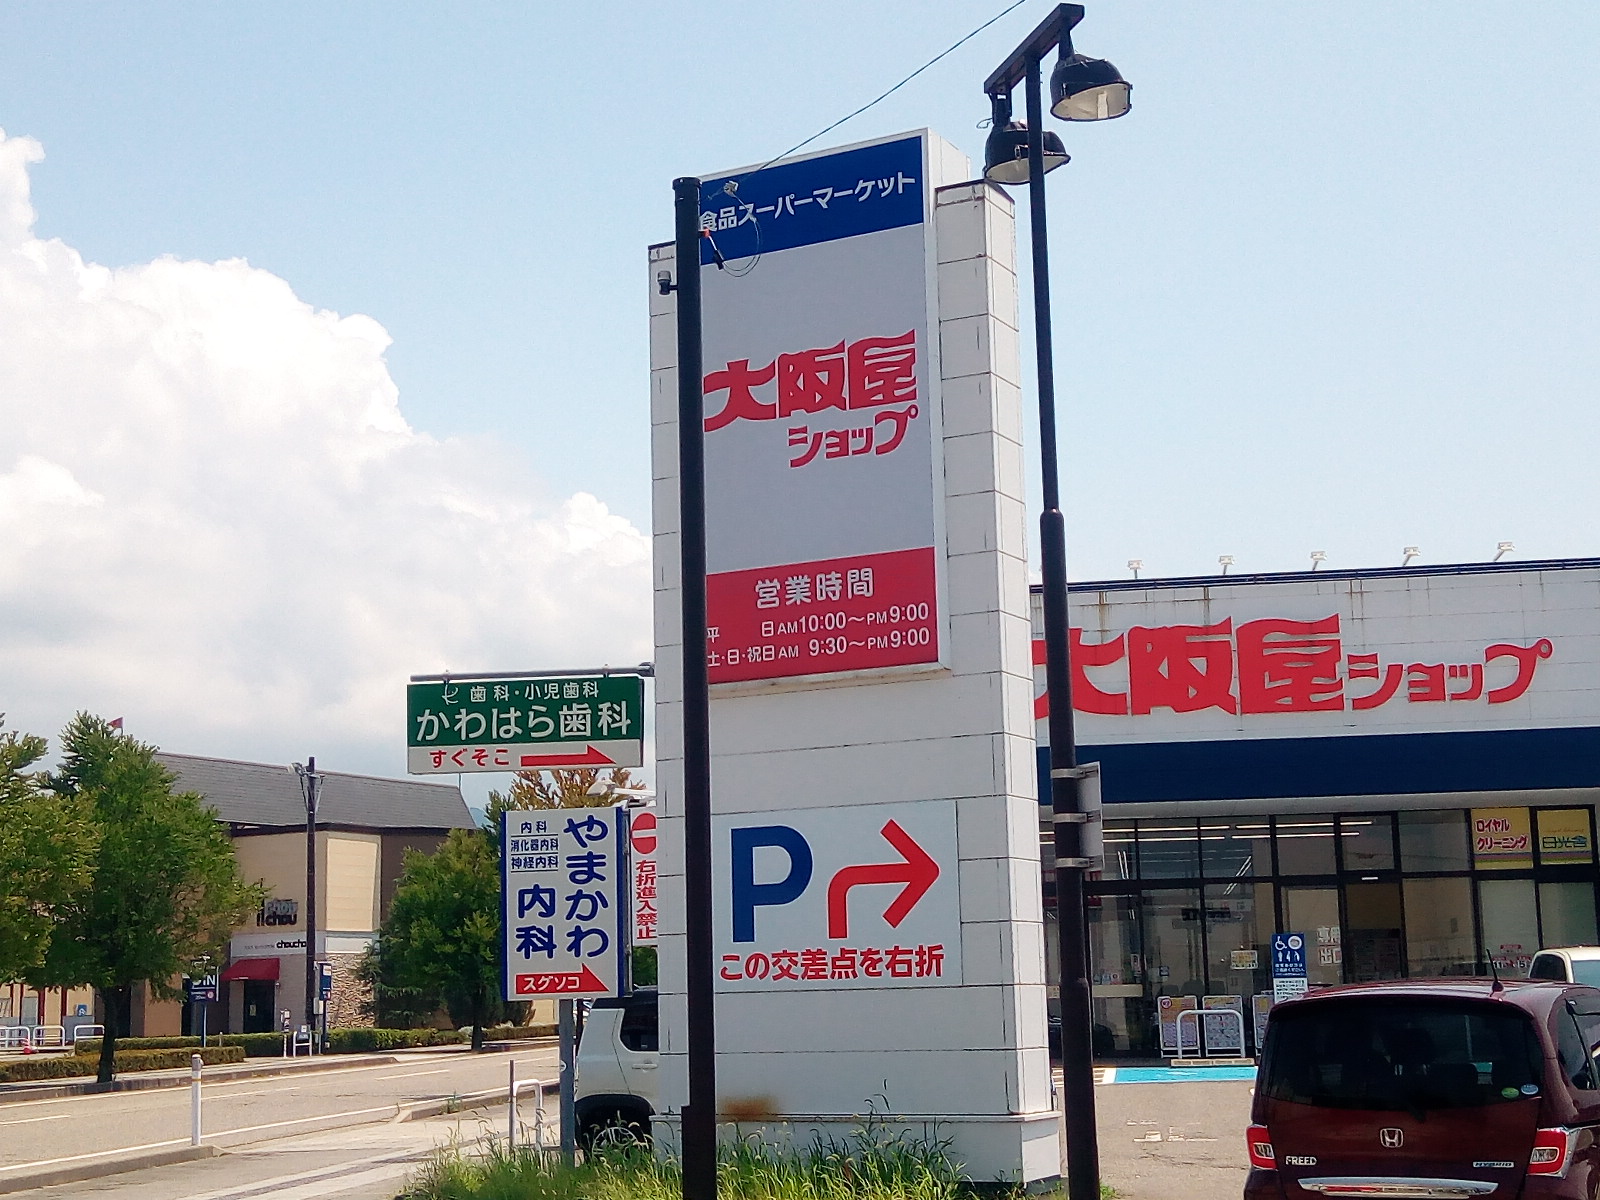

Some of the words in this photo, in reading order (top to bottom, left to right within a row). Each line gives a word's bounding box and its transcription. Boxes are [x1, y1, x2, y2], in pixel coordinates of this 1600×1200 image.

[700, 171, 916, 233] 食品スーパーマーケット
[703, 328, 918, 432] 大阪屋
[788, 404, 918, 468] ショップ
[755, 567, 874, 609] 営業時間
[416, 700, 632, 742] かわはら歯科
[429, 748, 510, 769] すぐそこ
[510, 838, 559, 852] 消化器内科
[520, 821, 547, 834] 内科
[1475, 818, 1510, 833] ロイヤル
[1477, 835, 1529, 851] クリーニング
[511, 855, 559, 870] 神経内科
[563, 814, 609, 958] やまかわ
[635, 859, 658, 940] 右折進入禁止
[731, 825, 813, 943] P
[515, 883, 557, 960] 内科
[719, 944, 945, 982] この交差点を右折
[523, 976, 581, 992] スグソコ
[1285, 1155, 1317, 1166] FREED
